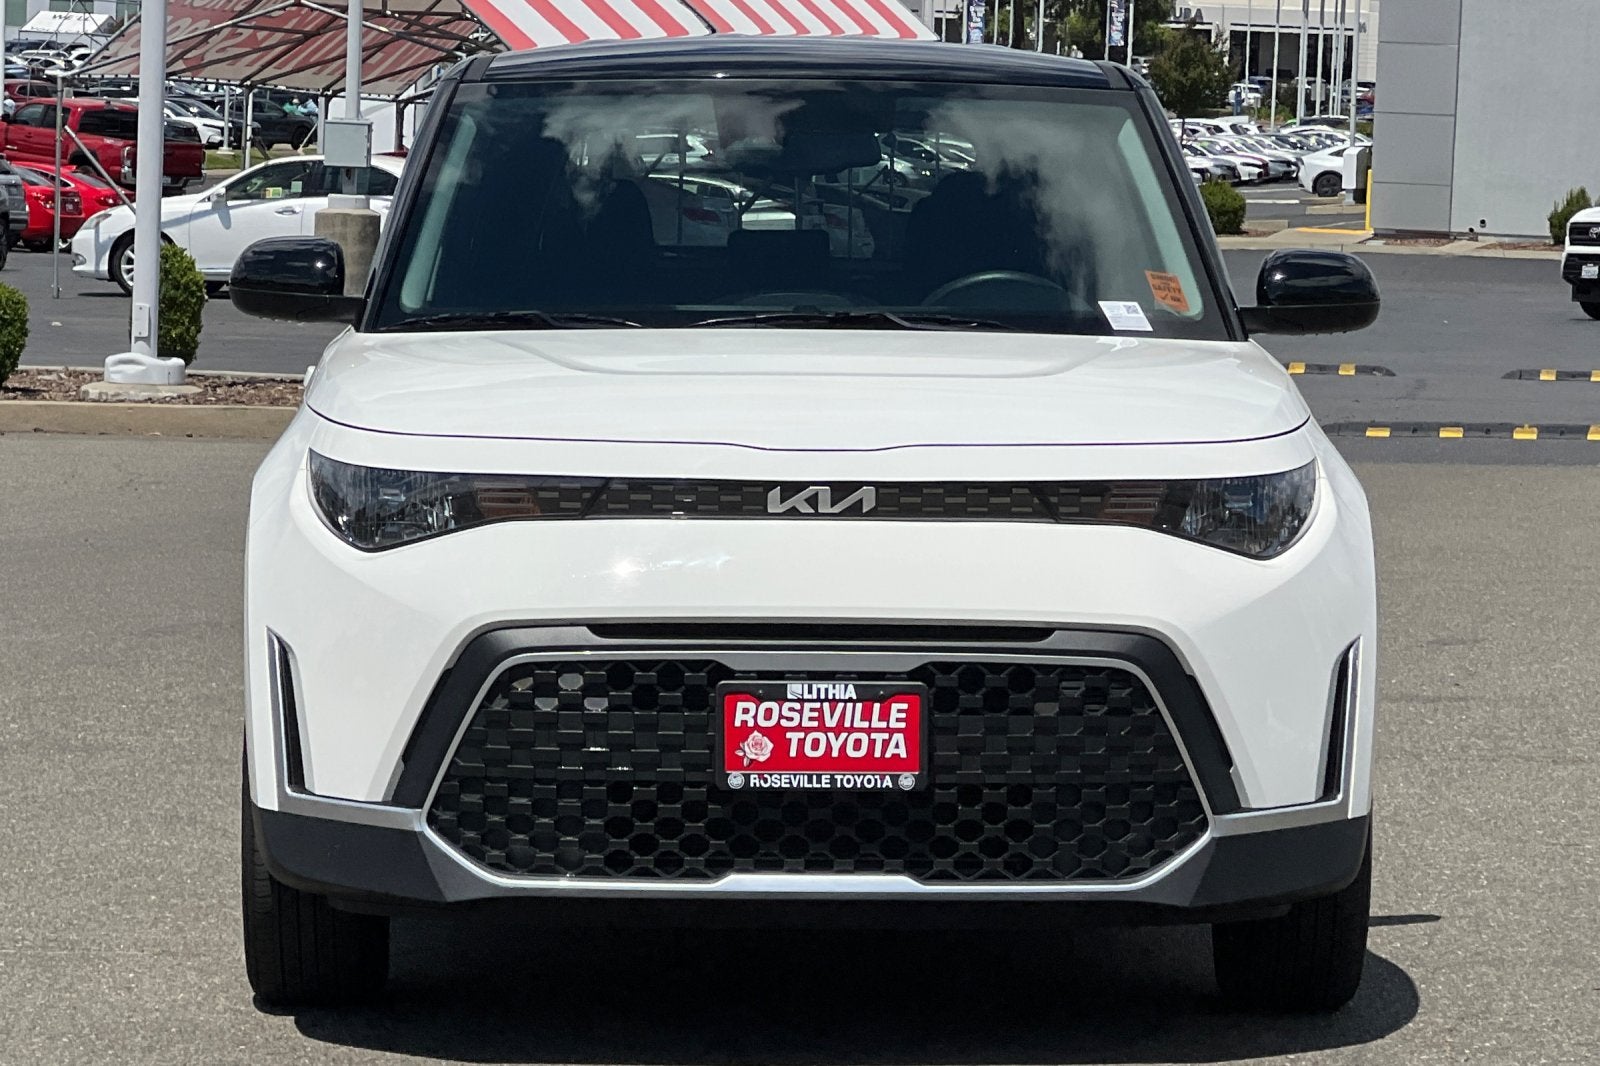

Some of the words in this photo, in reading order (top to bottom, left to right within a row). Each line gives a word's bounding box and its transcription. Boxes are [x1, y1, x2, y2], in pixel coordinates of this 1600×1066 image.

[767, 486, 876, 513] KIA
[802, 683, 857, 699] LITHIA
[734, 701, 909, 728] ROSEVILLE
[786, 731, 908, 758] TOYOTA
[750, 774, 831, 788] ROSEVILLE
[834, 774, 893, 789] TOYOTA
